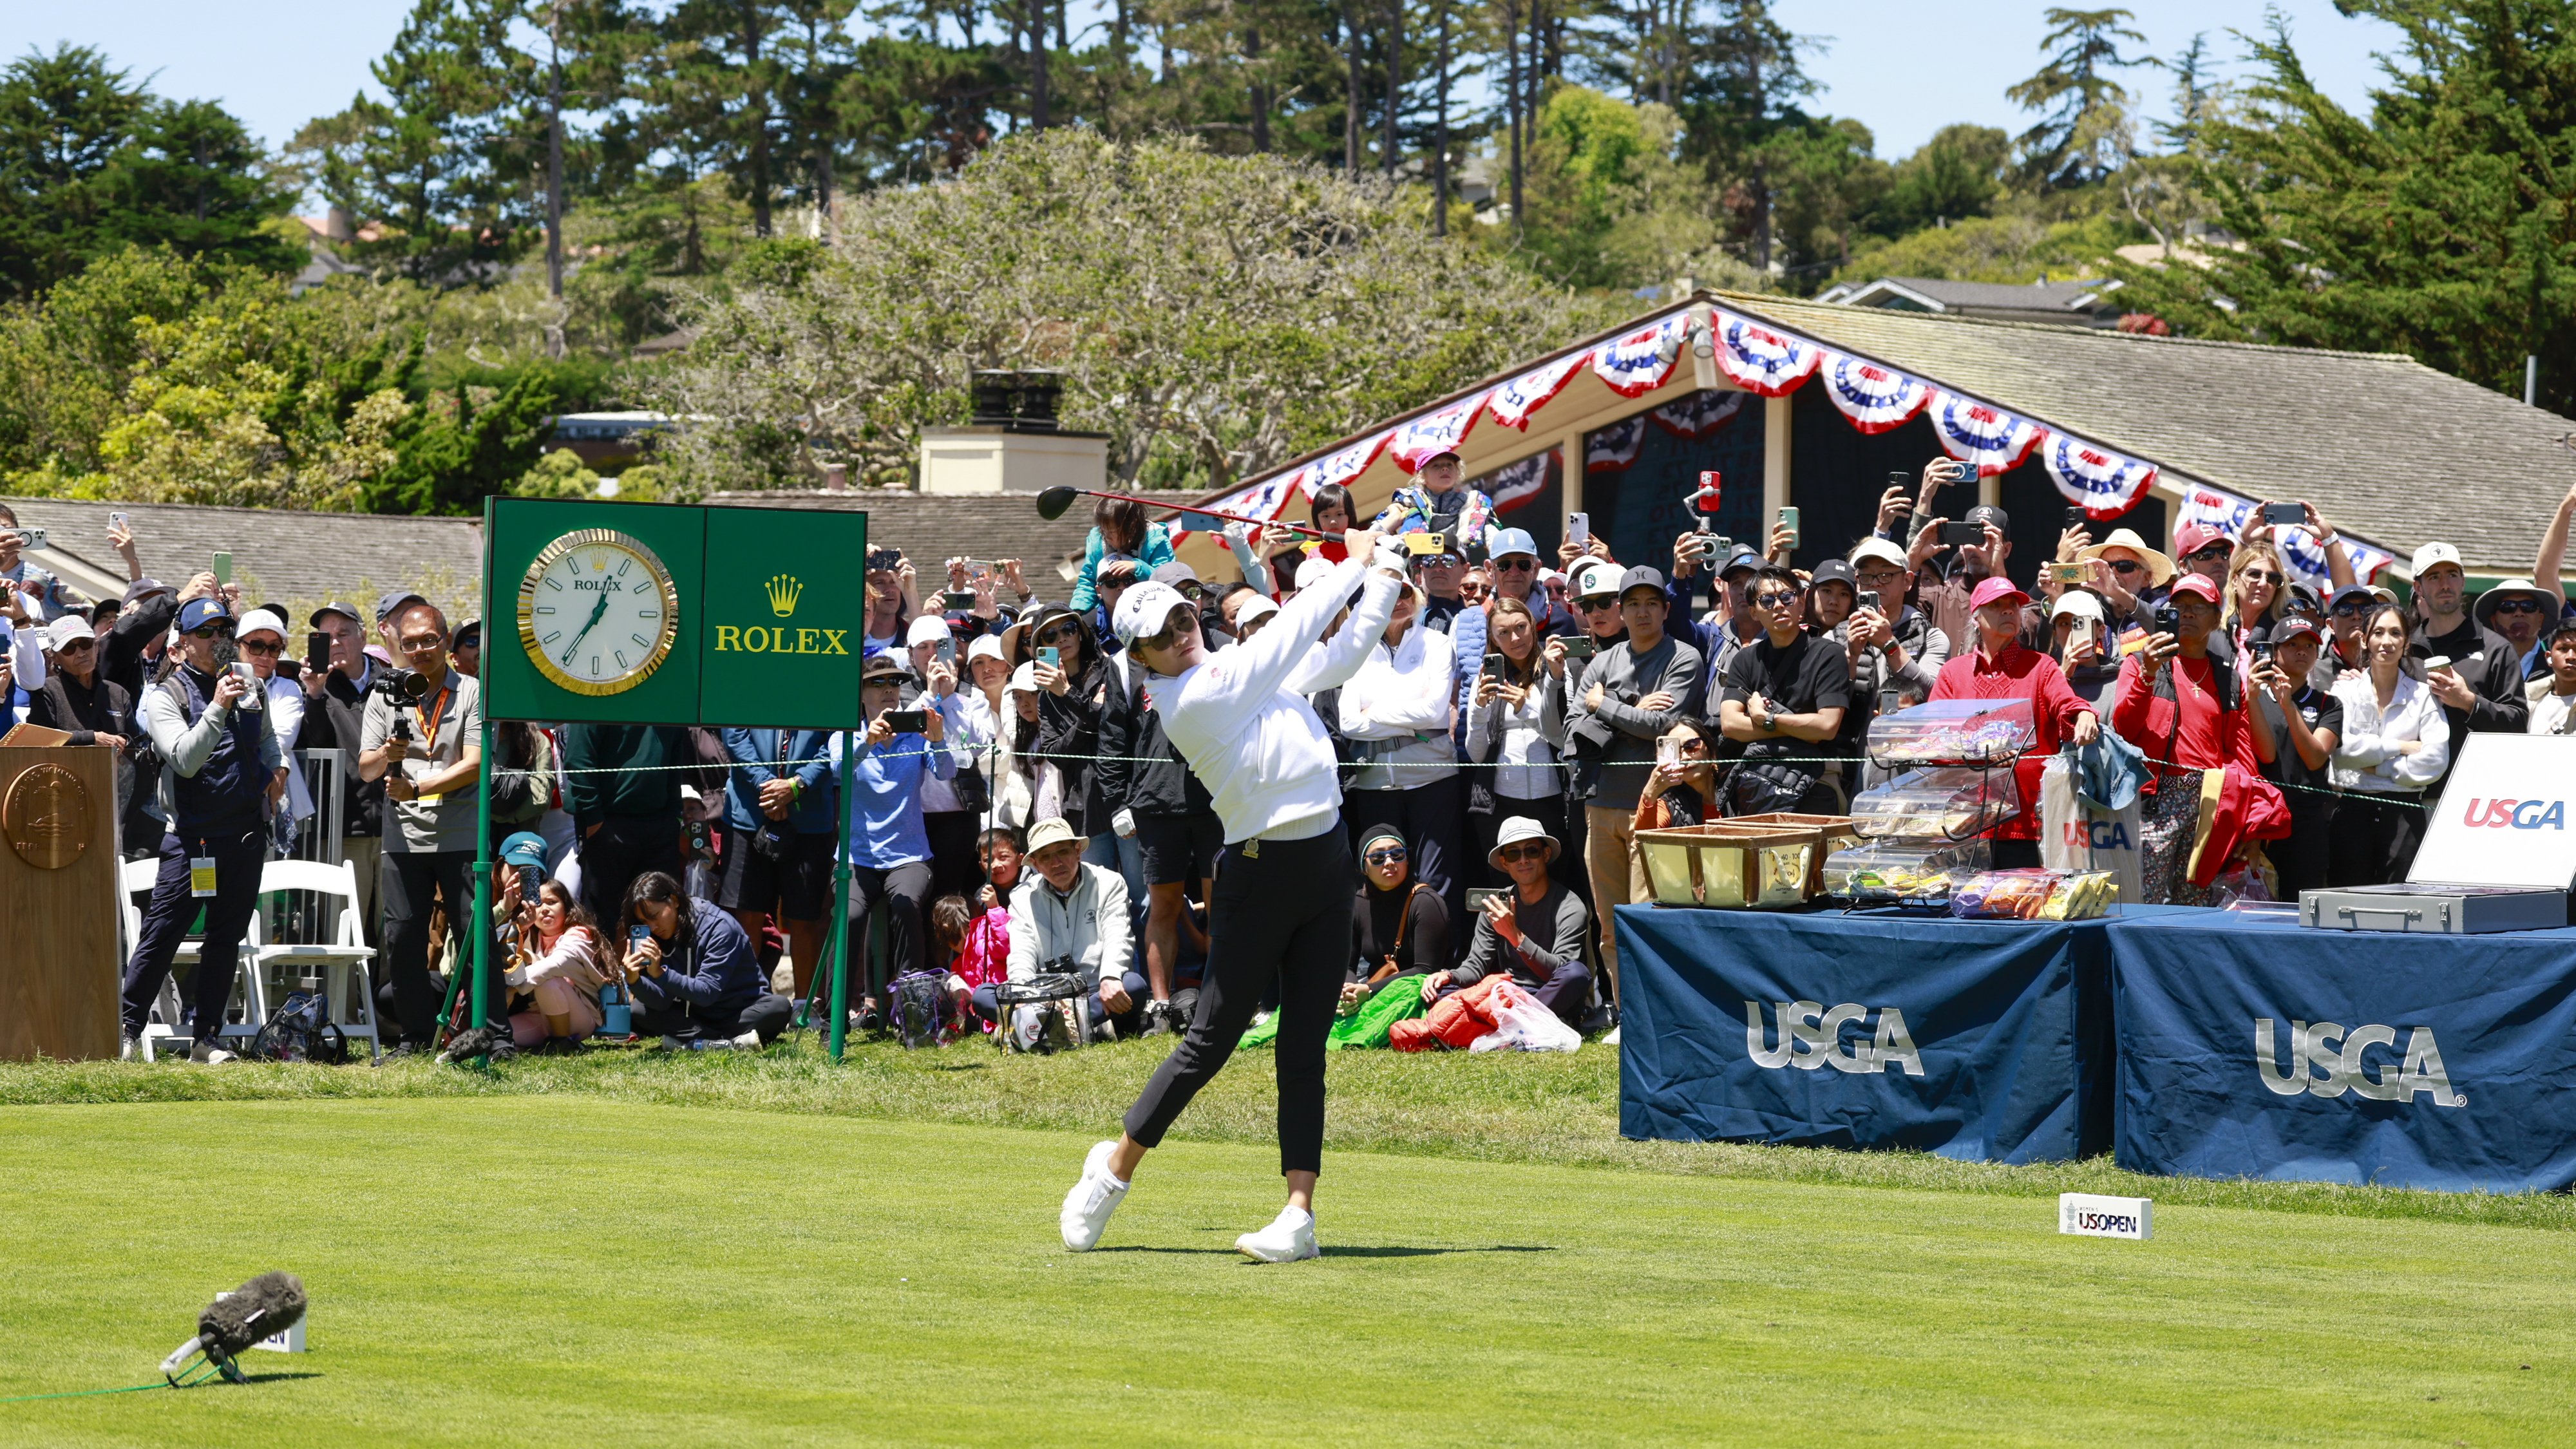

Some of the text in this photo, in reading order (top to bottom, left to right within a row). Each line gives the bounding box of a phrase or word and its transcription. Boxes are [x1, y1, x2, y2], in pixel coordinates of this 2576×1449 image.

[2199, 524, 2216, 538] S
[1133, 587, 1166, 612] Callaway
[2286, 618, 2313, 628] IZOD
[715, 625, 848, 655] ROLEX
[2464, 798, 2564, 830] USGA
[1745, 1000, 1925, 1076] USGA
